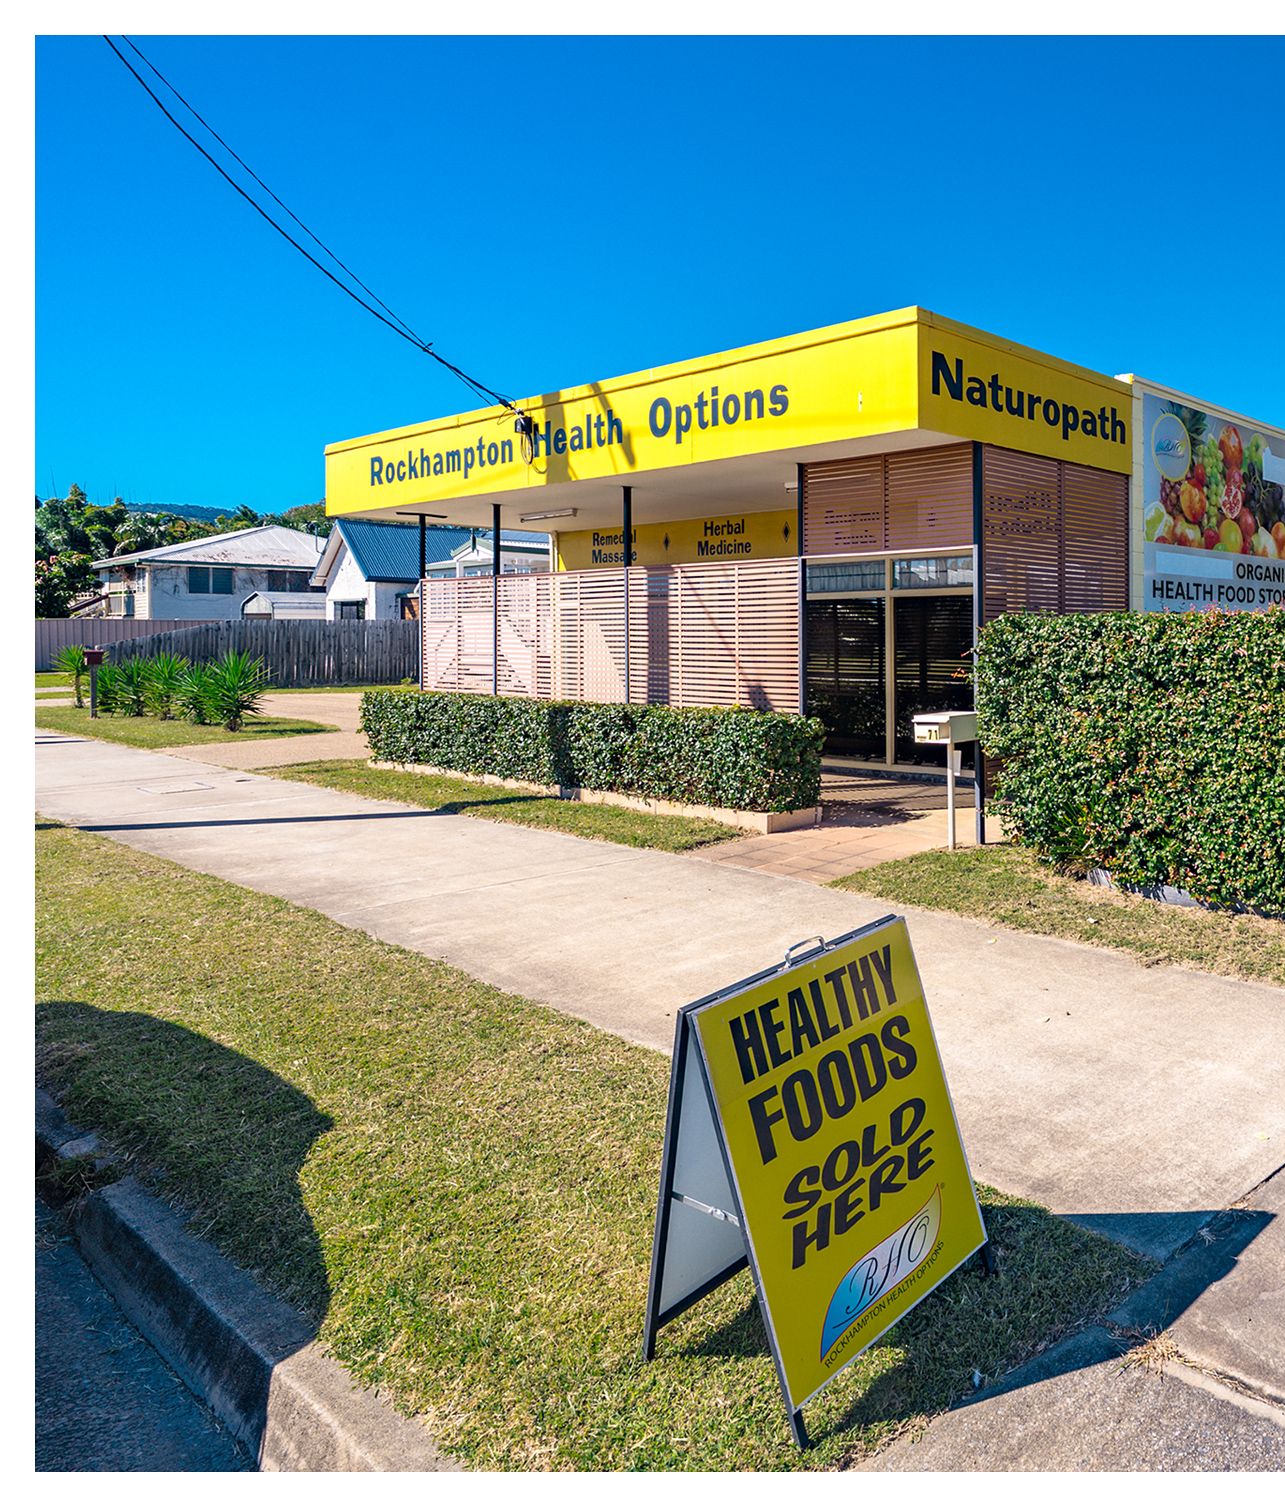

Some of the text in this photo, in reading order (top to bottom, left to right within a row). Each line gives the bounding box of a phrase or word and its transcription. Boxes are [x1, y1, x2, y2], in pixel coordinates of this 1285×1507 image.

[370, 384, 789, 486] Rockhampton Health Options
[932, 350, 1126, 444] Naturopath
[592, 549, 638, 563] Massae
[697, 539, 752, 556] Medicine
[704, 518, 744, 537] Herbal
[1152, 579, 1214, 602] HEALTH
[1217, 585, 1256, 604] FOOD
[928, 729, 938, 740] 71
[729, 944, 897, 1085] HEALTHY
[748, 1015, 917, 1165] FOODS
[782, 1097, 926, 1219] SOLD
[792, 1129, 935, 1270] HERE
[824, 1240, 945, 1368] ROCKHAMPTON HEALTH OPTIONS
[833, 1209, 930, 1329] RHO
